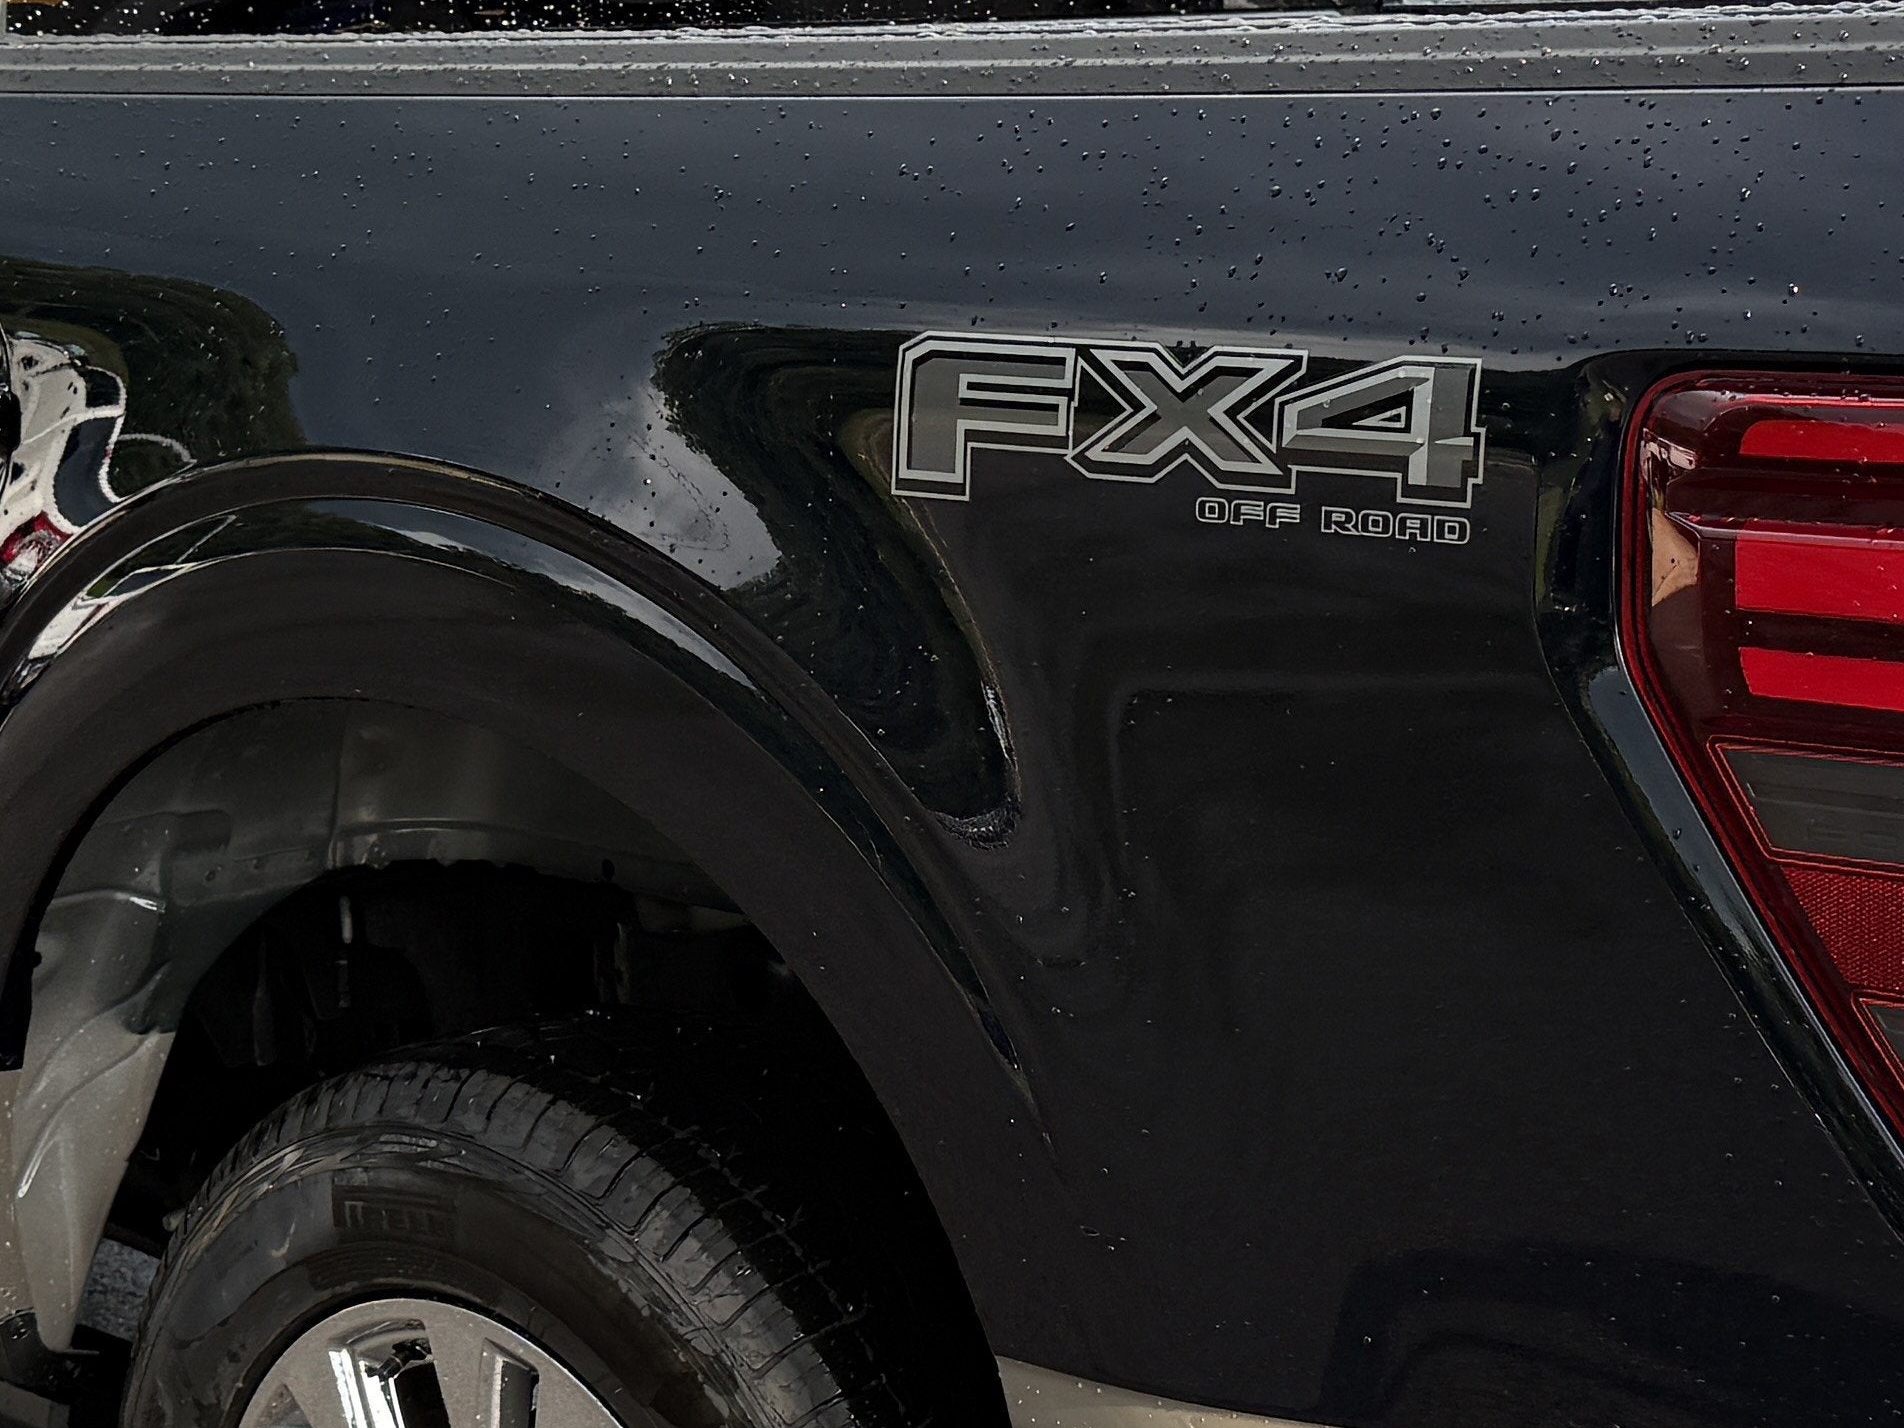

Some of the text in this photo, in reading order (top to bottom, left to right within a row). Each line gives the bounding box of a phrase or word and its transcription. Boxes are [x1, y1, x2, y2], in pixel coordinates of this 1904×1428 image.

[891, 331, 1485, 507] FX4
[1195, 496, 1471, 544] OFF ROAD
